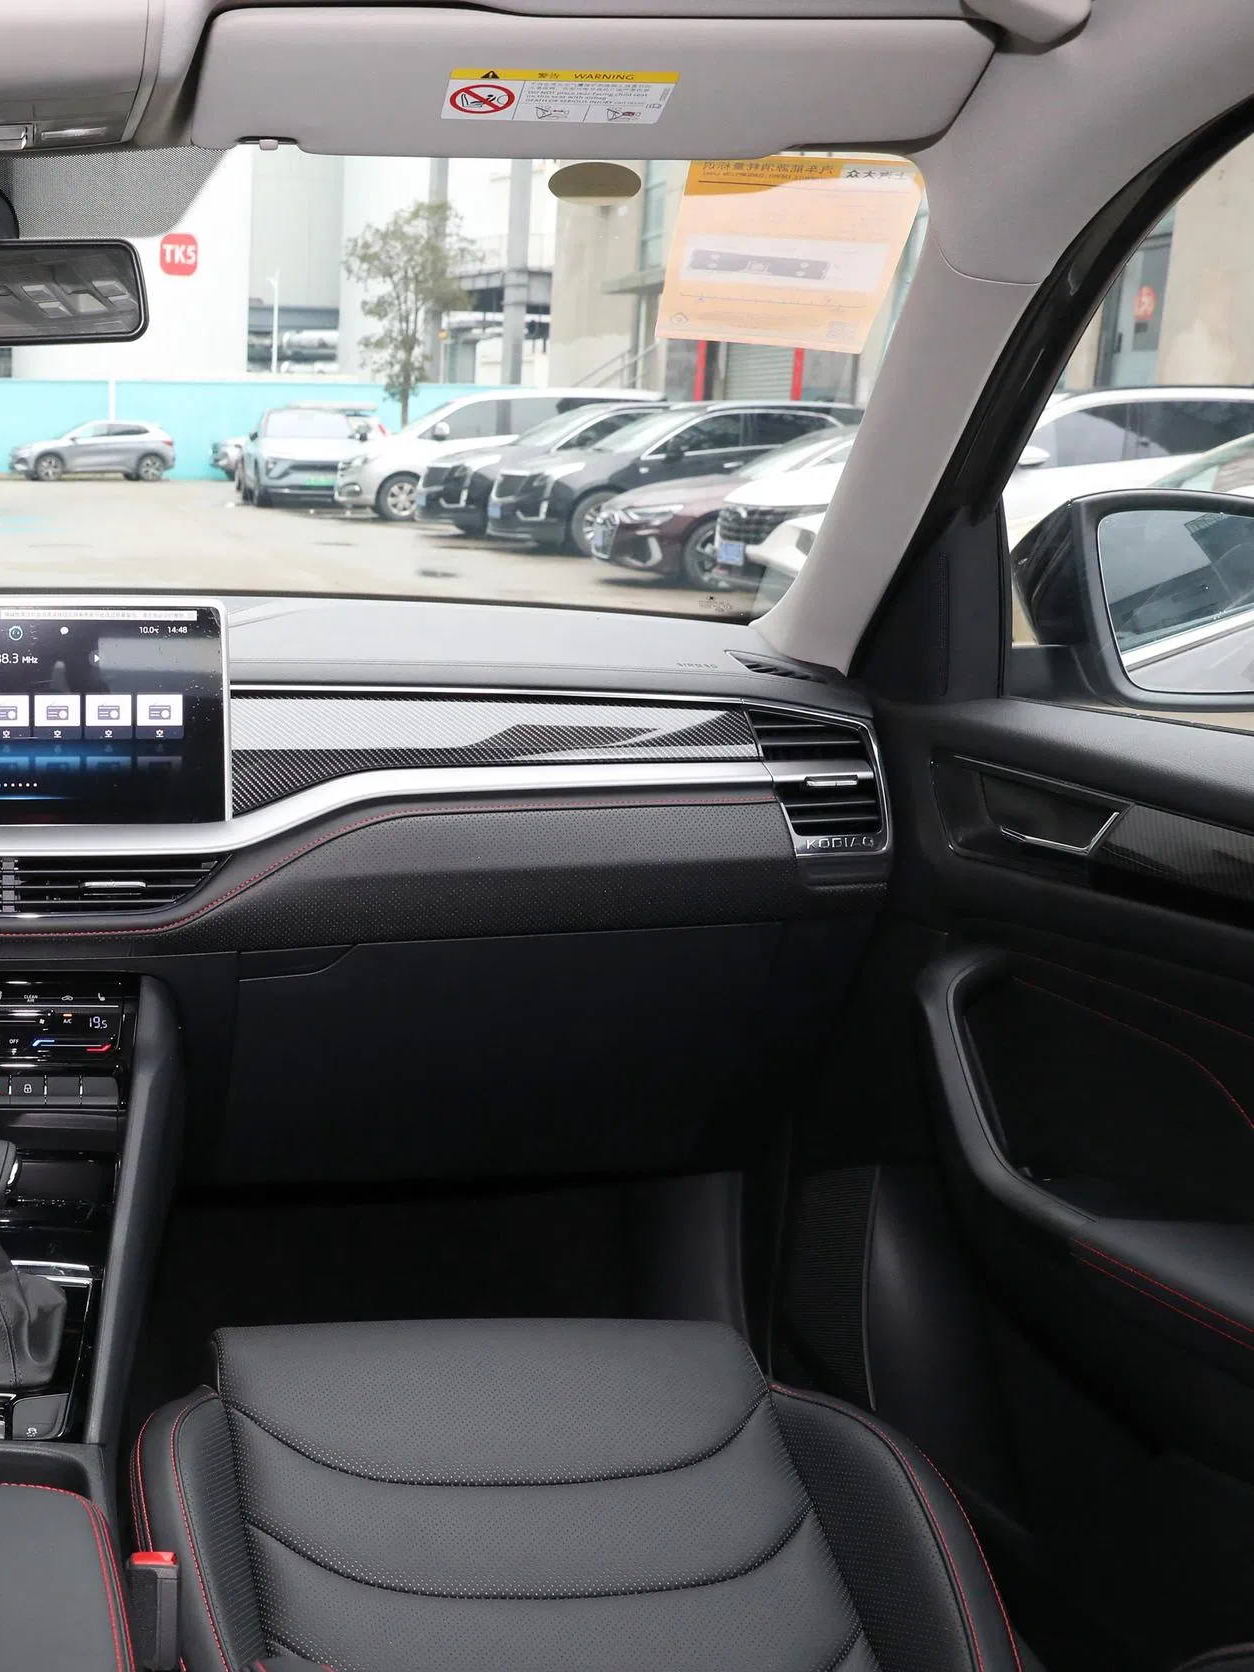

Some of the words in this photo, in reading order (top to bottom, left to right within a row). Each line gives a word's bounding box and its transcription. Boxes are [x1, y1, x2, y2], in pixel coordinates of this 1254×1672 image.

[162, 243, 196, 265] TK5
[167, 626, 188, 634] 14:48
[22, 656, 39, 664] MHz
[806, 836, 874, 849] KODIAQ
[89, 1016, 108, 1029] 19.5
